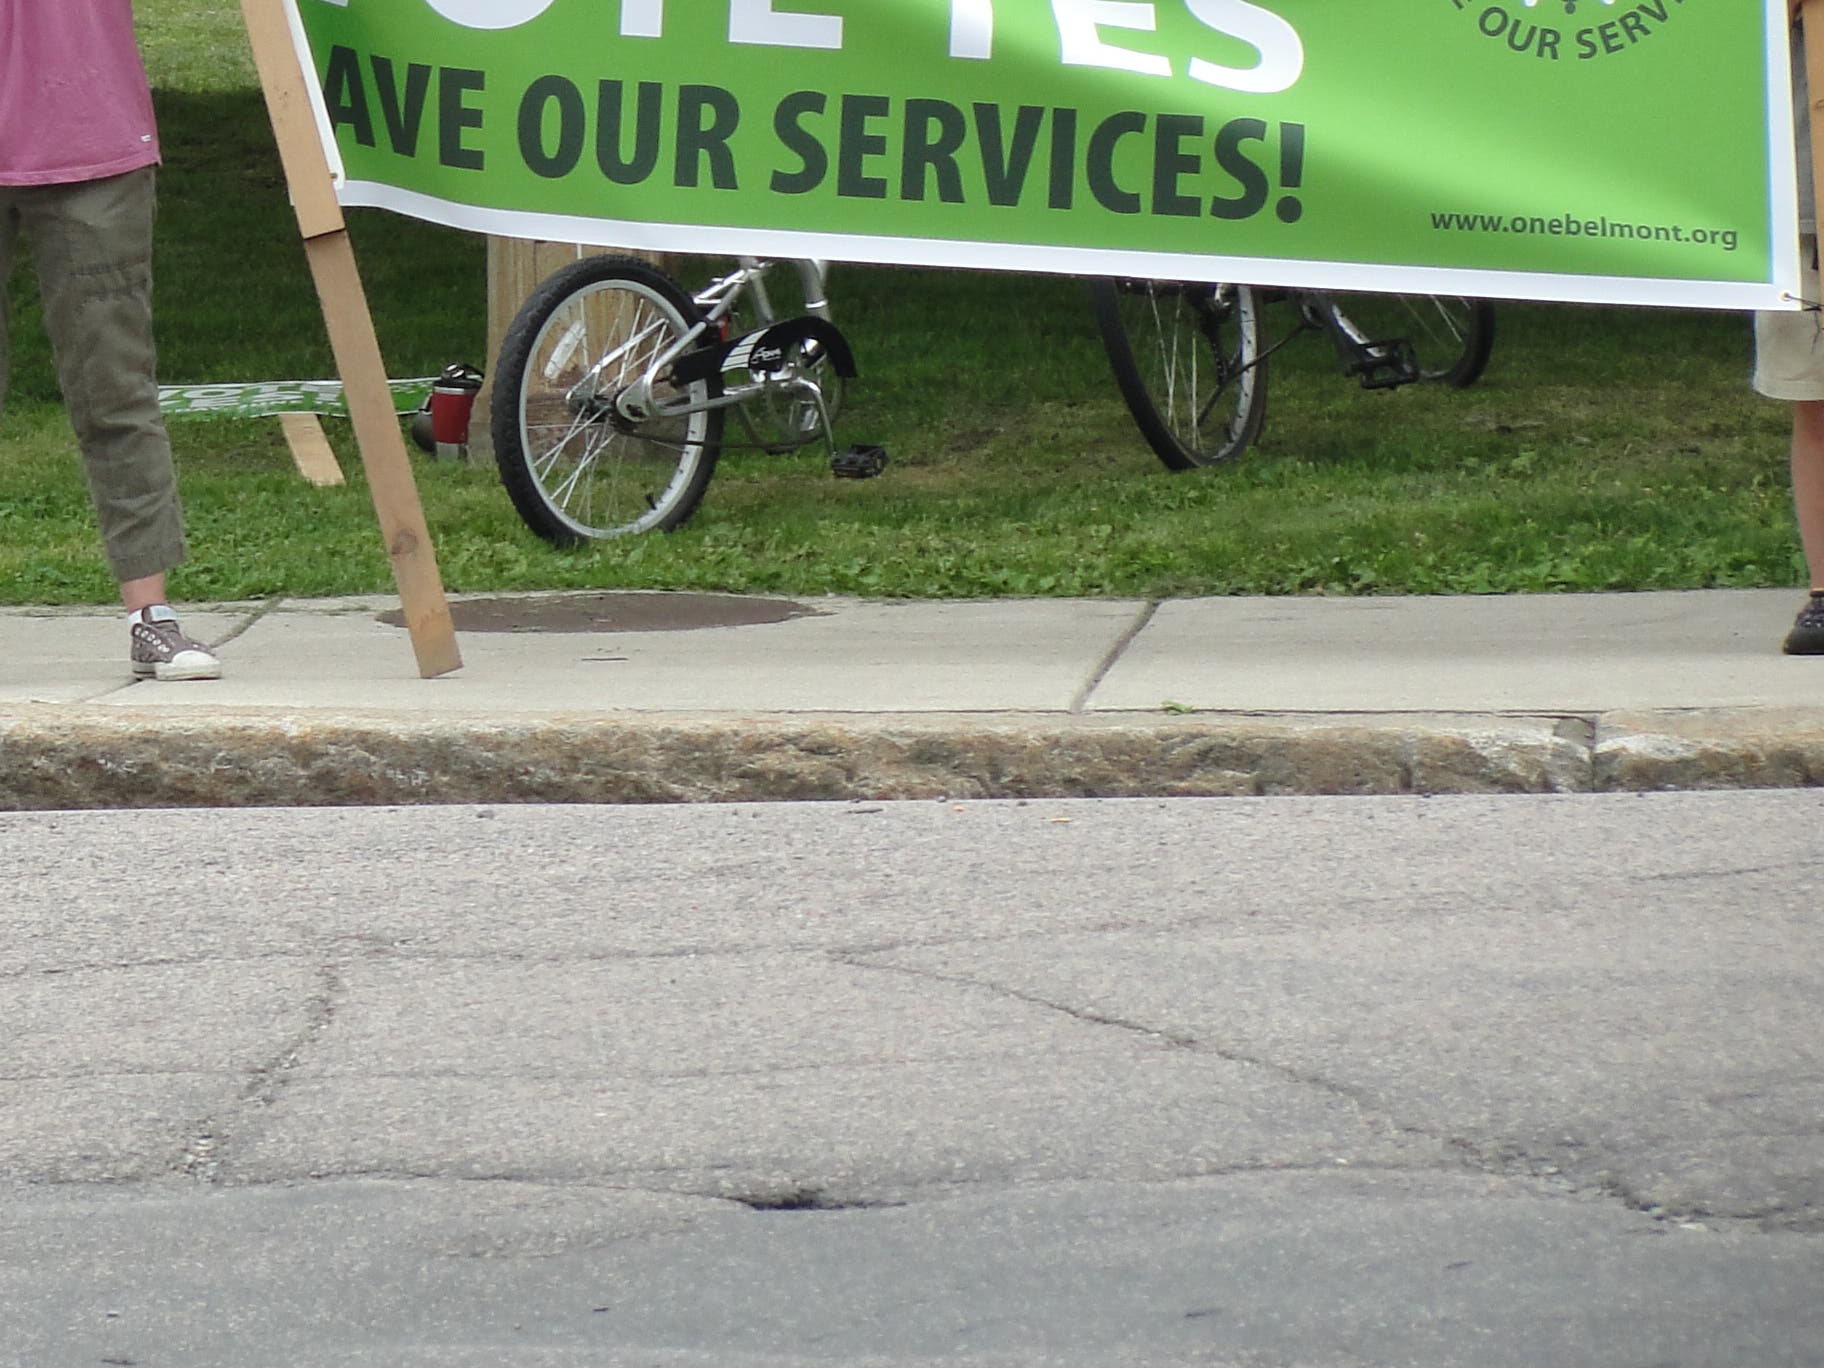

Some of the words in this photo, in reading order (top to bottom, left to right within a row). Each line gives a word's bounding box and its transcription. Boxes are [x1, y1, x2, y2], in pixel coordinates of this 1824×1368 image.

[1478, 6, 1561, 60] OUR
[325, 44, 485, 172] AVE
[518, 74, 741, 191] OUR
[771, 90, 1306, 224] SERVICES!
[1431, 212, 1739, 251] www.onebelmont.org
